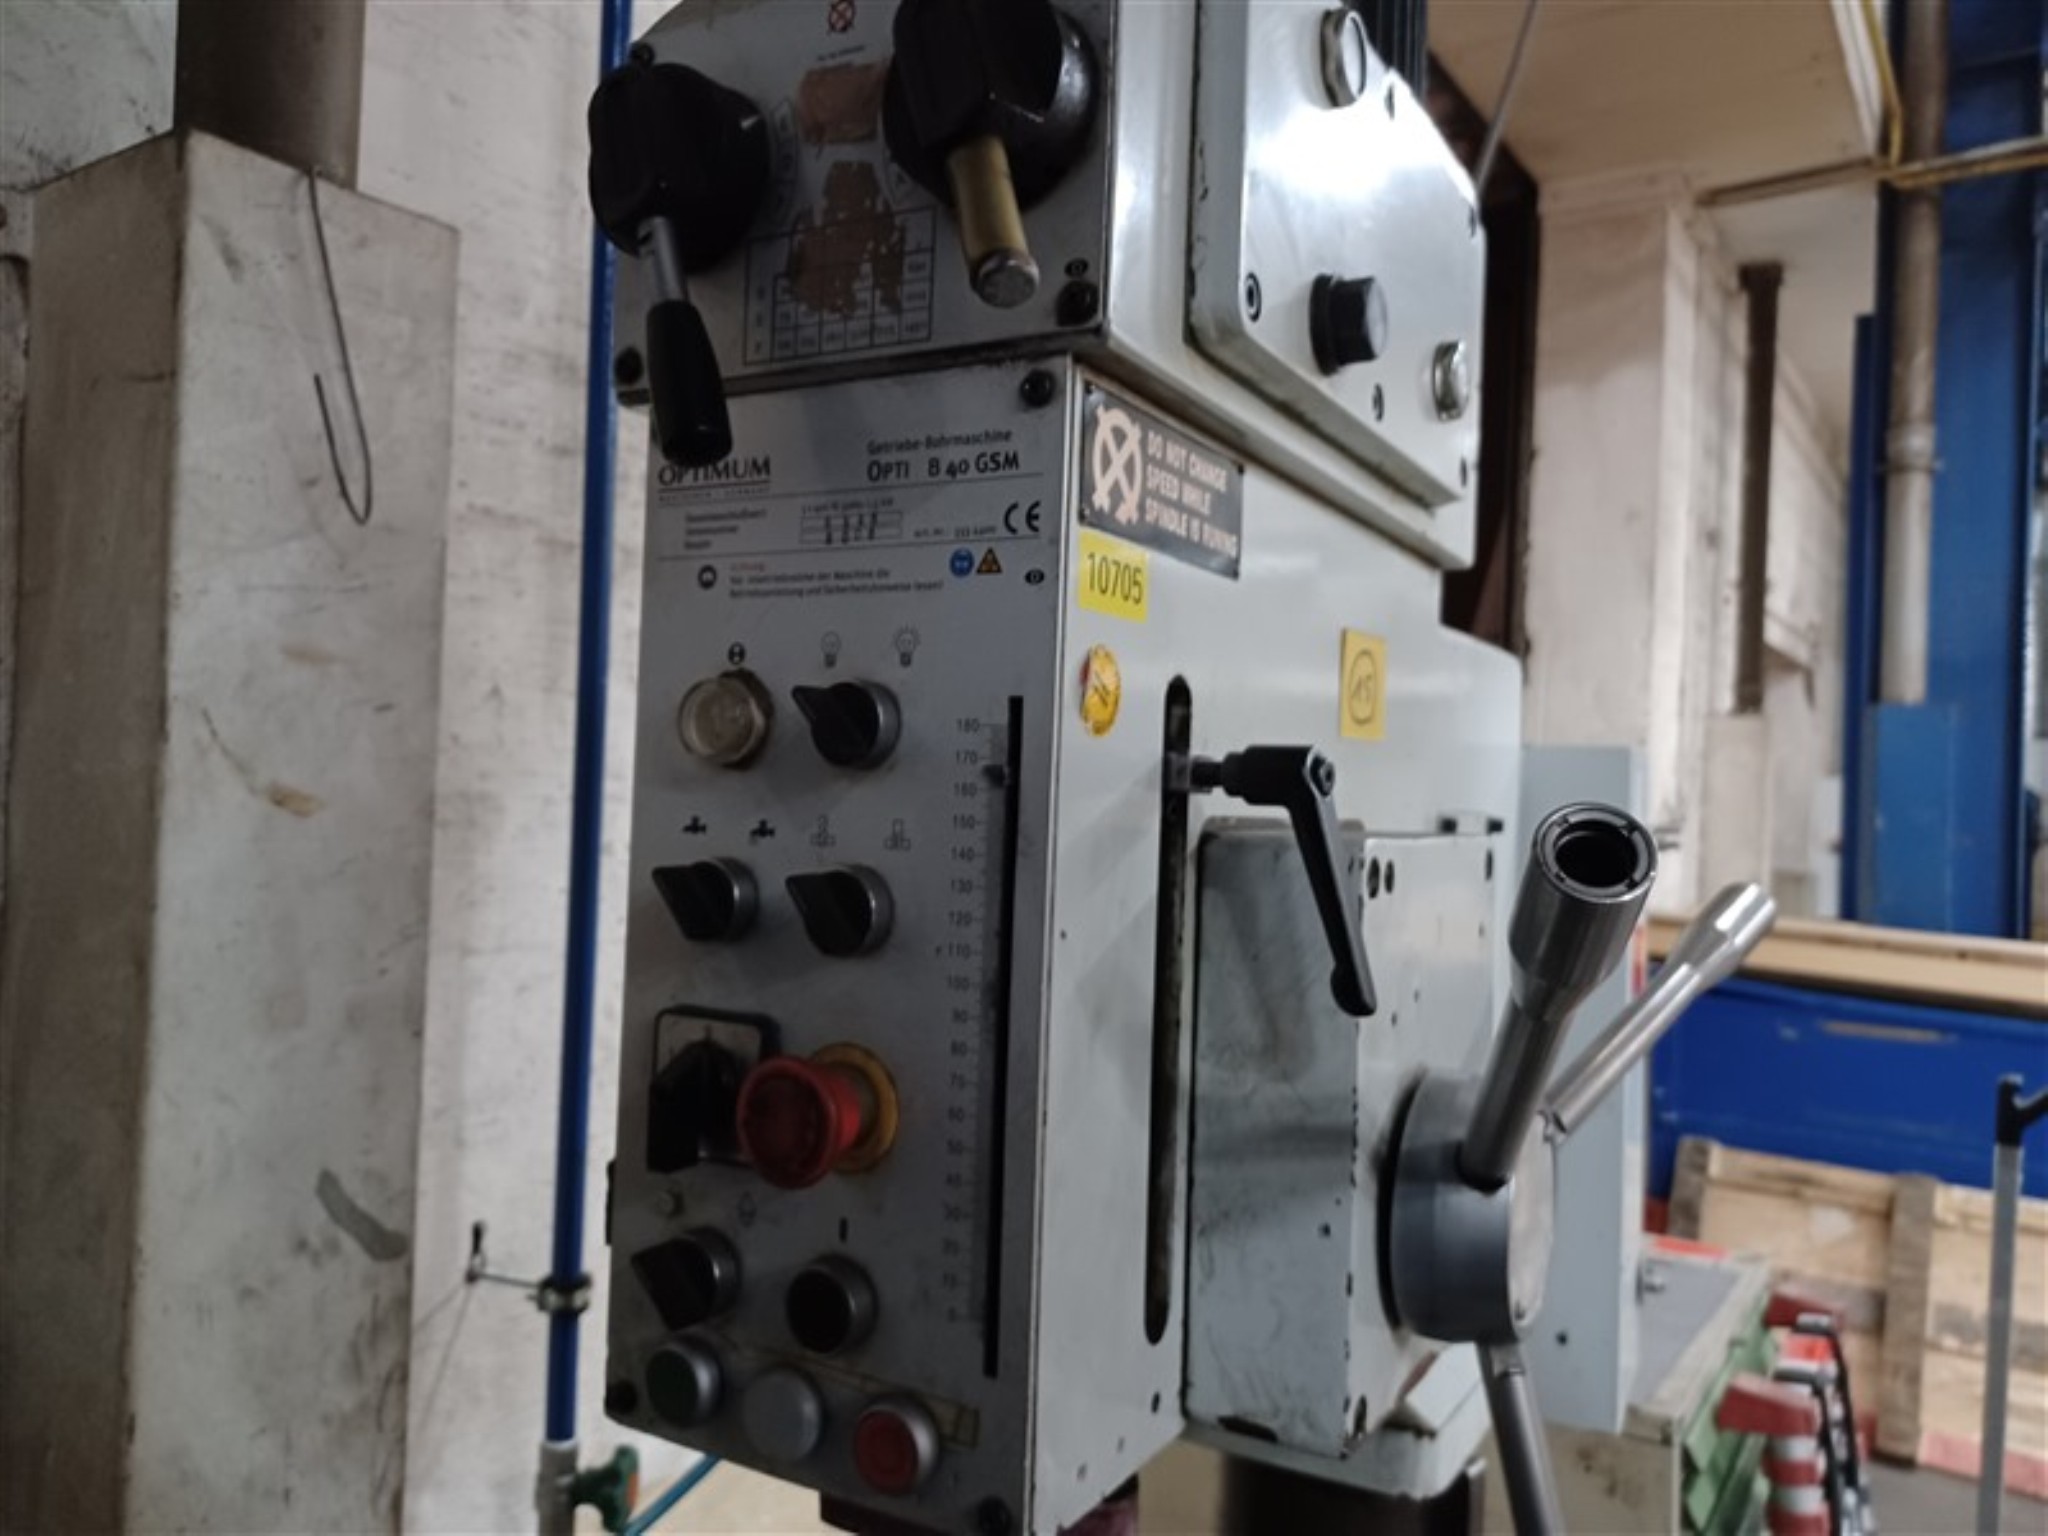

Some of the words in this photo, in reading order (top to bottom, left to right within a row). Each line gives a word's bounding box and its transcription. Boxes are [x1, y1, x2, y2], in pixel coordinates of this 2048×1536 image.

[866, 429, 1013, 456] Getriebe-Bohrmaschine
[927, 456, 941, 478] B
[945, 457, 971, 480] 40
[974, 450, 1020, 475] GSM
[1147, 430, 1163, 459] DO
[1165, 440, 1186, 471] NOT
[1189, 450, 1227, 493] CHANGE
[1146, 463, 1179, 500] SPEED
[1145, 496, 1187, 538] SPINDLE
[1088, 551, 1142, 606] 10705
[955, 751, 978, 765] 170
